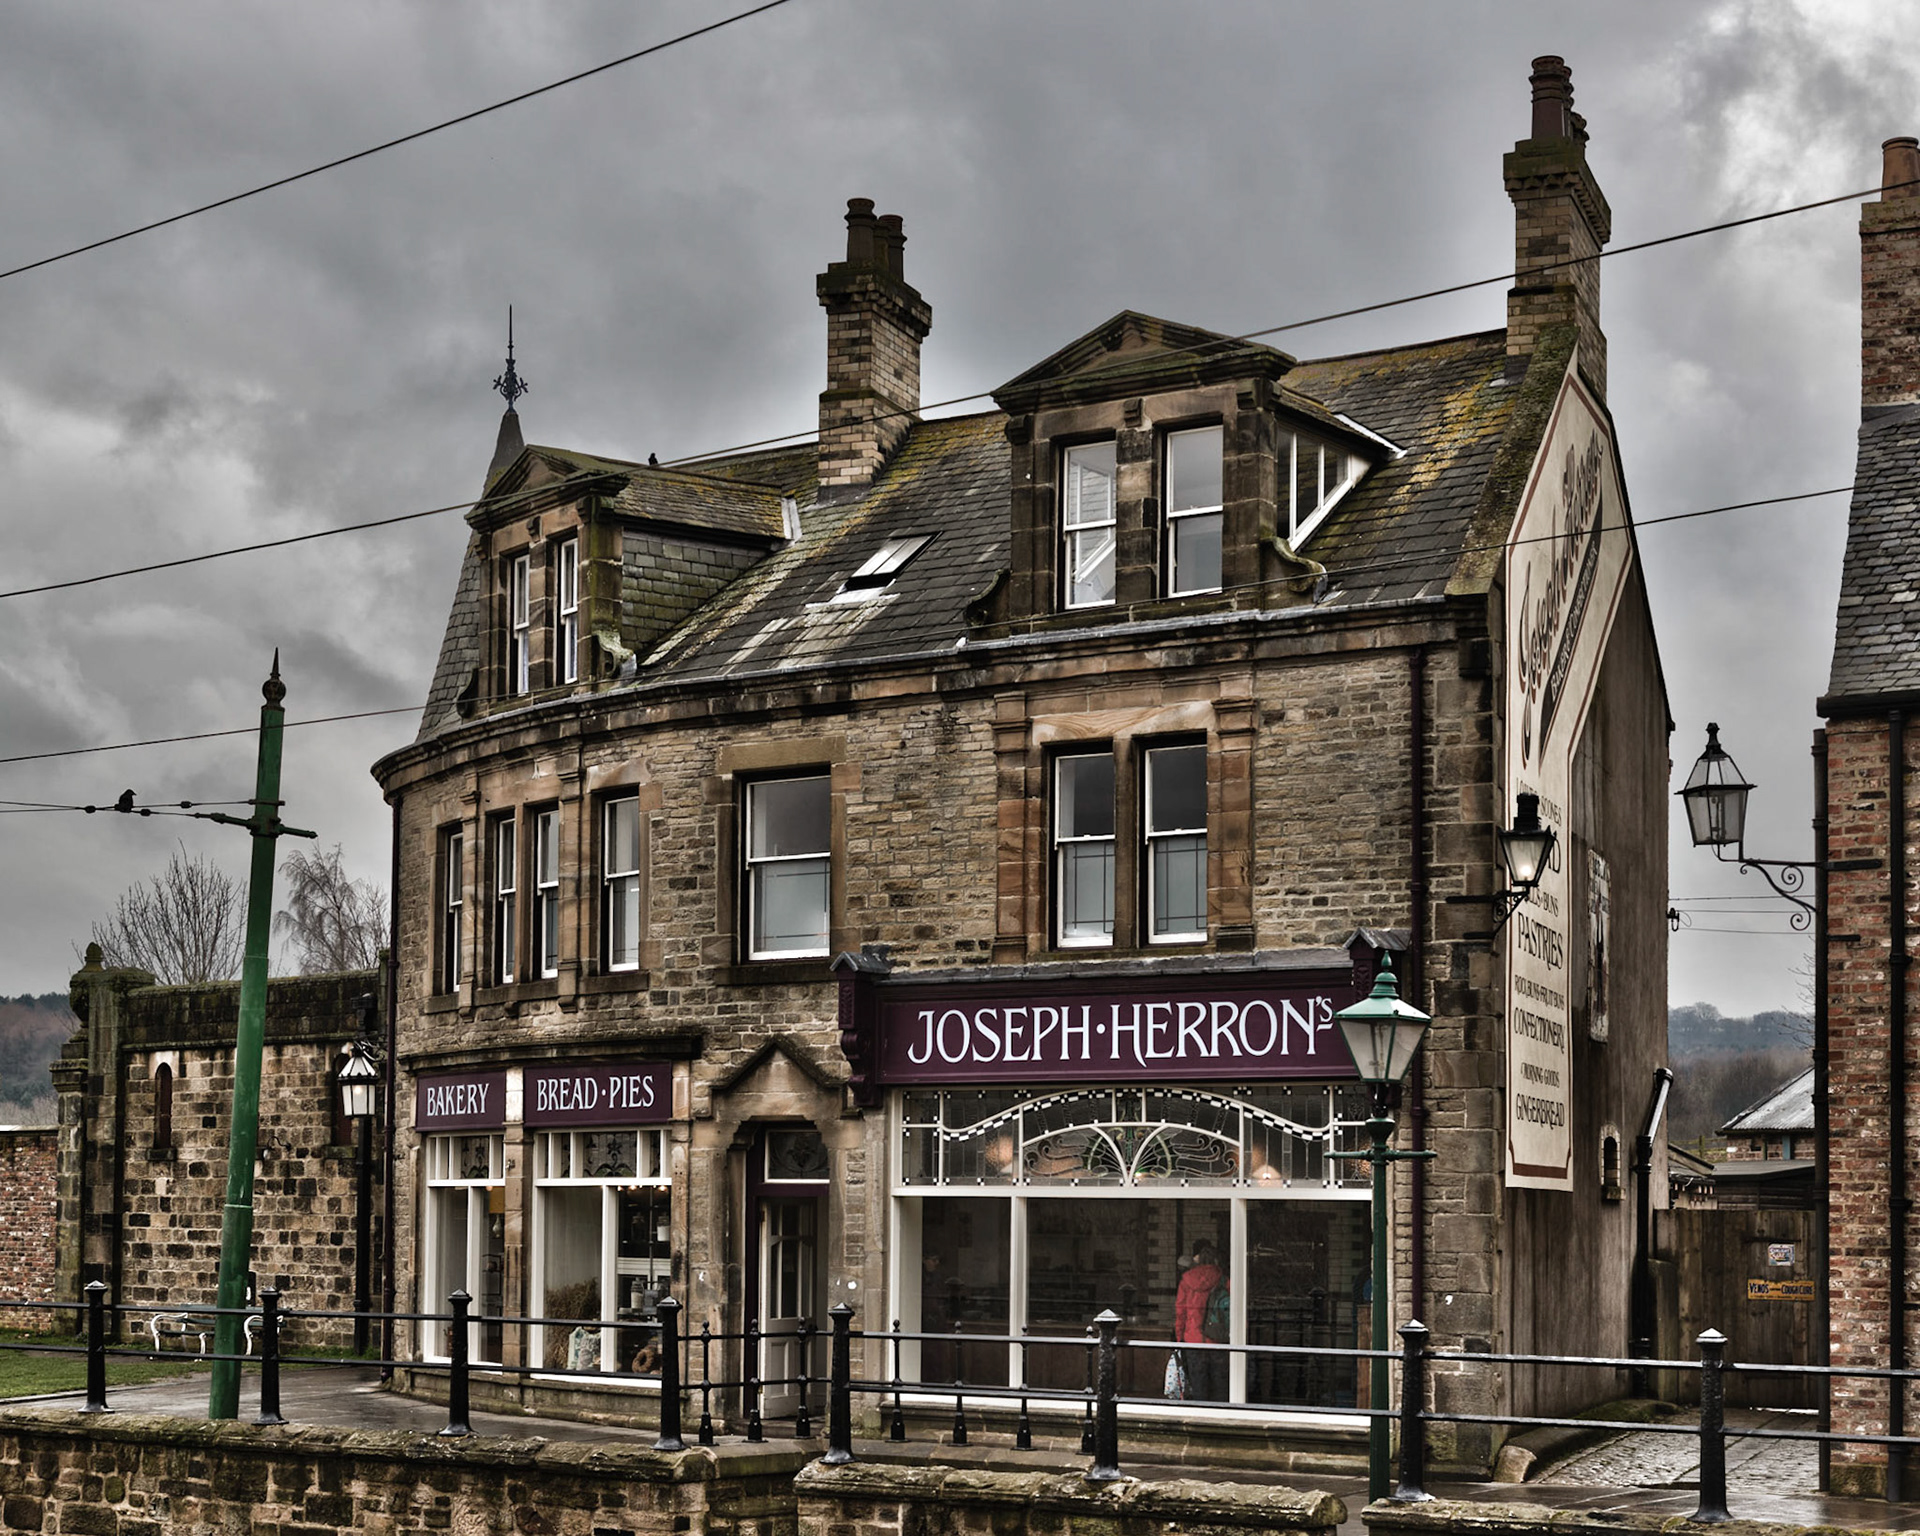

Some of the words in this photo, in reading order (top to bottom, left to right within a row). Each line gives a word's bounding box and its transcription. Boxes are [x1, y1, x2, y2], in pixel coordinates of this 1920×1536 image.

[1518, 504, 1564, 770] Joseph
[1517, 911, 1564, 971] PASTRIES
[1514, 1007, 1566, 1054] CONFECTIONERY
[1544, 1068, 1560, 1088] GOODS
[426, 1083, 490, 1117] BAKERY
[1515, 1093, 1565, 1130] GINGERBREAD
